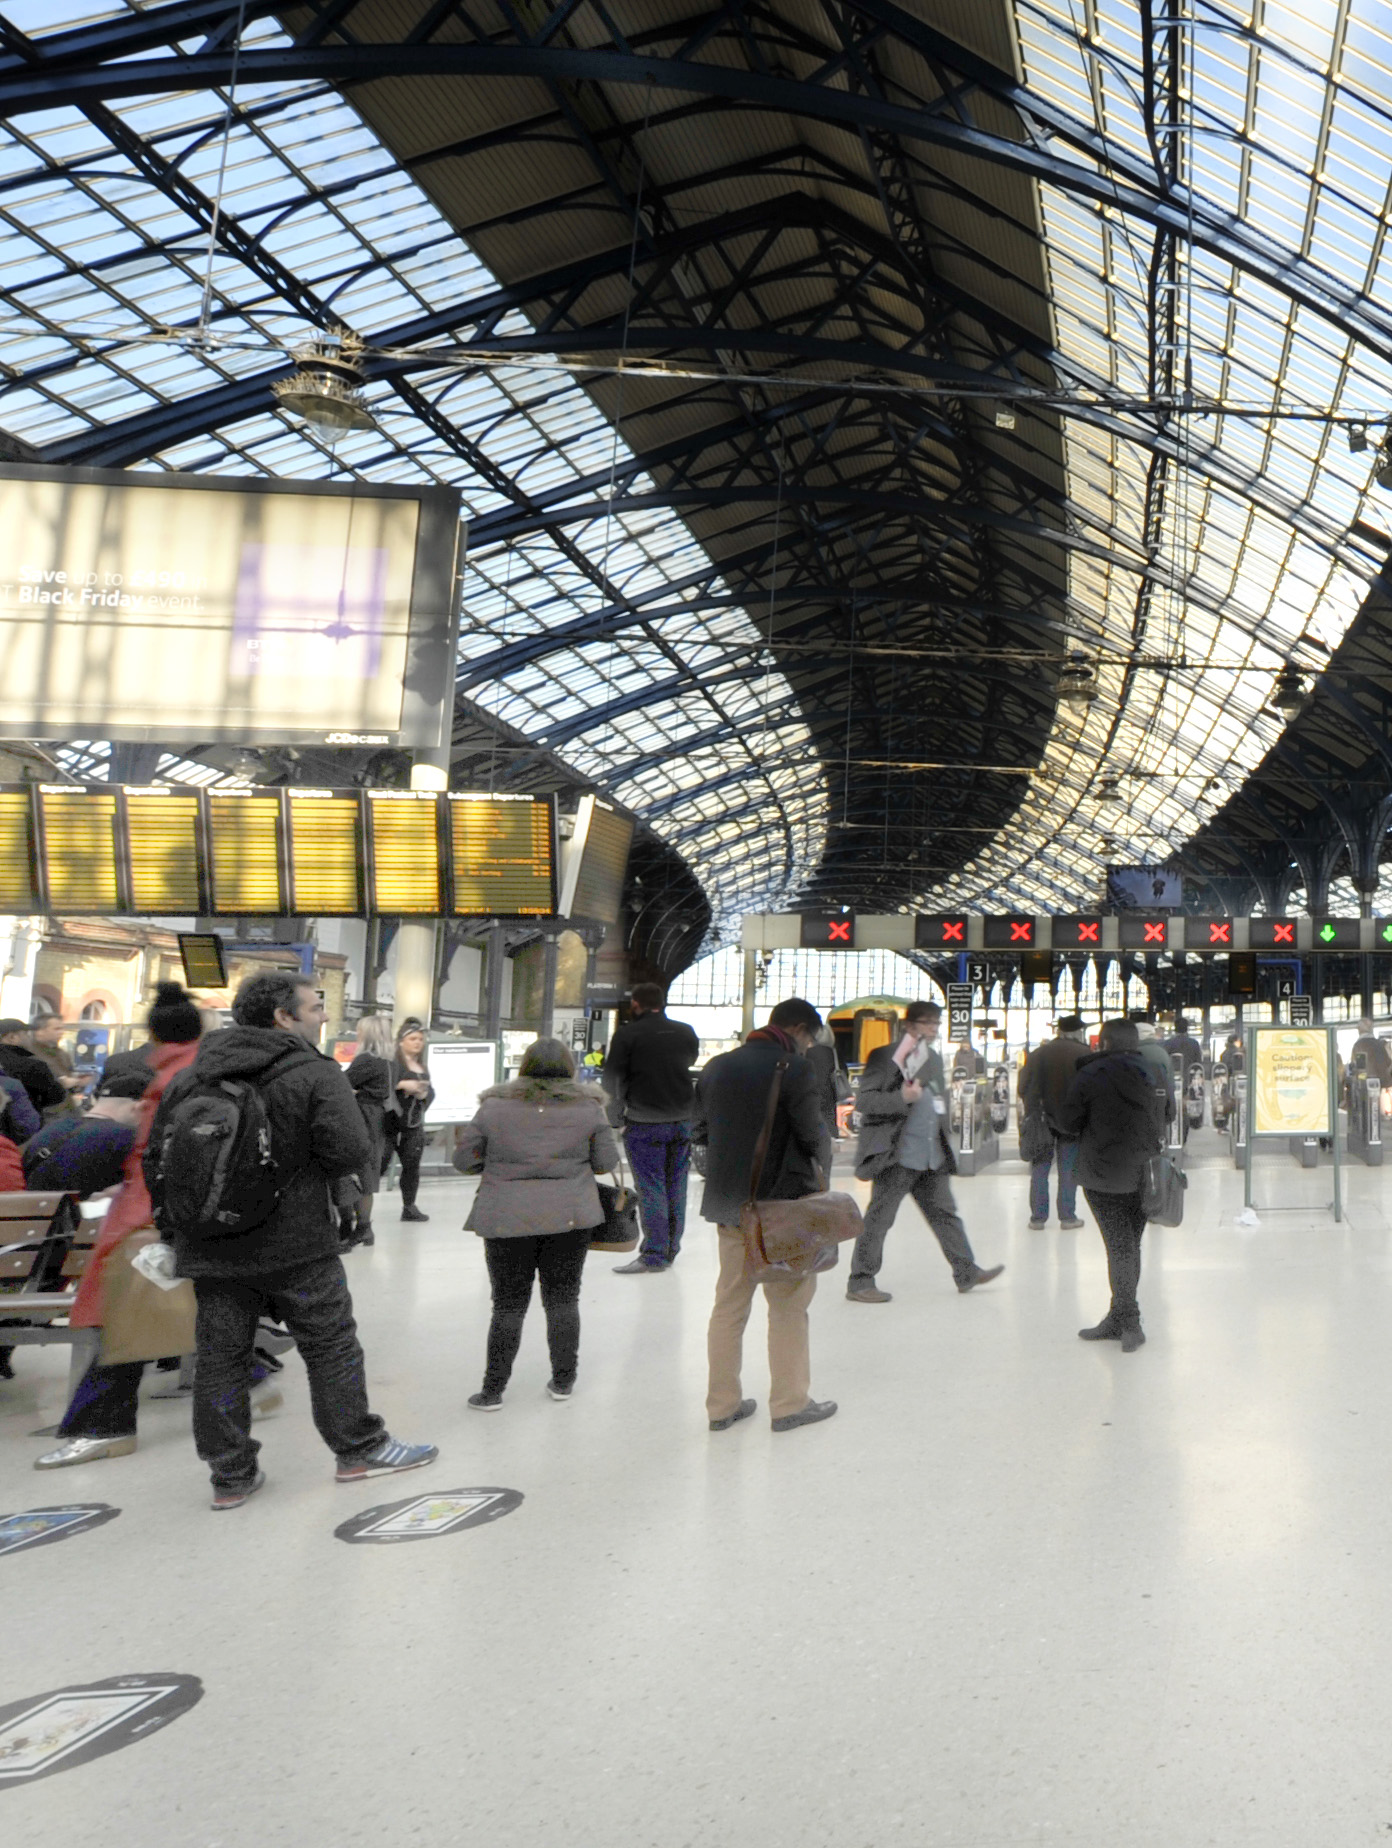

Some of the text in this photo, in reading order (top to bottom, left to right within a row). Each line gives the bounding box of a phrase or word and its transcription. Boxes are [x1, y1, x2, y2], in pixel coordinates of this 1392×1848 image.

[18, 565, 68, 584] Save
[73, 572, 99, 587] up
[104, 571, 124, 586] to
[130, 570, 186, 588] £490
[18, 586, 74, 605] Black
[80, 588, 144, 611] Friday
[149, 594, 206, 611] event.
[325, 732, 389, 745] JCDecaux
[493, 793, 534, 802] Departures
[973, 965, 983, 980] 3
[1282, 982, 1291, 995] 4
[951, 1010, 969, 1023] 30
